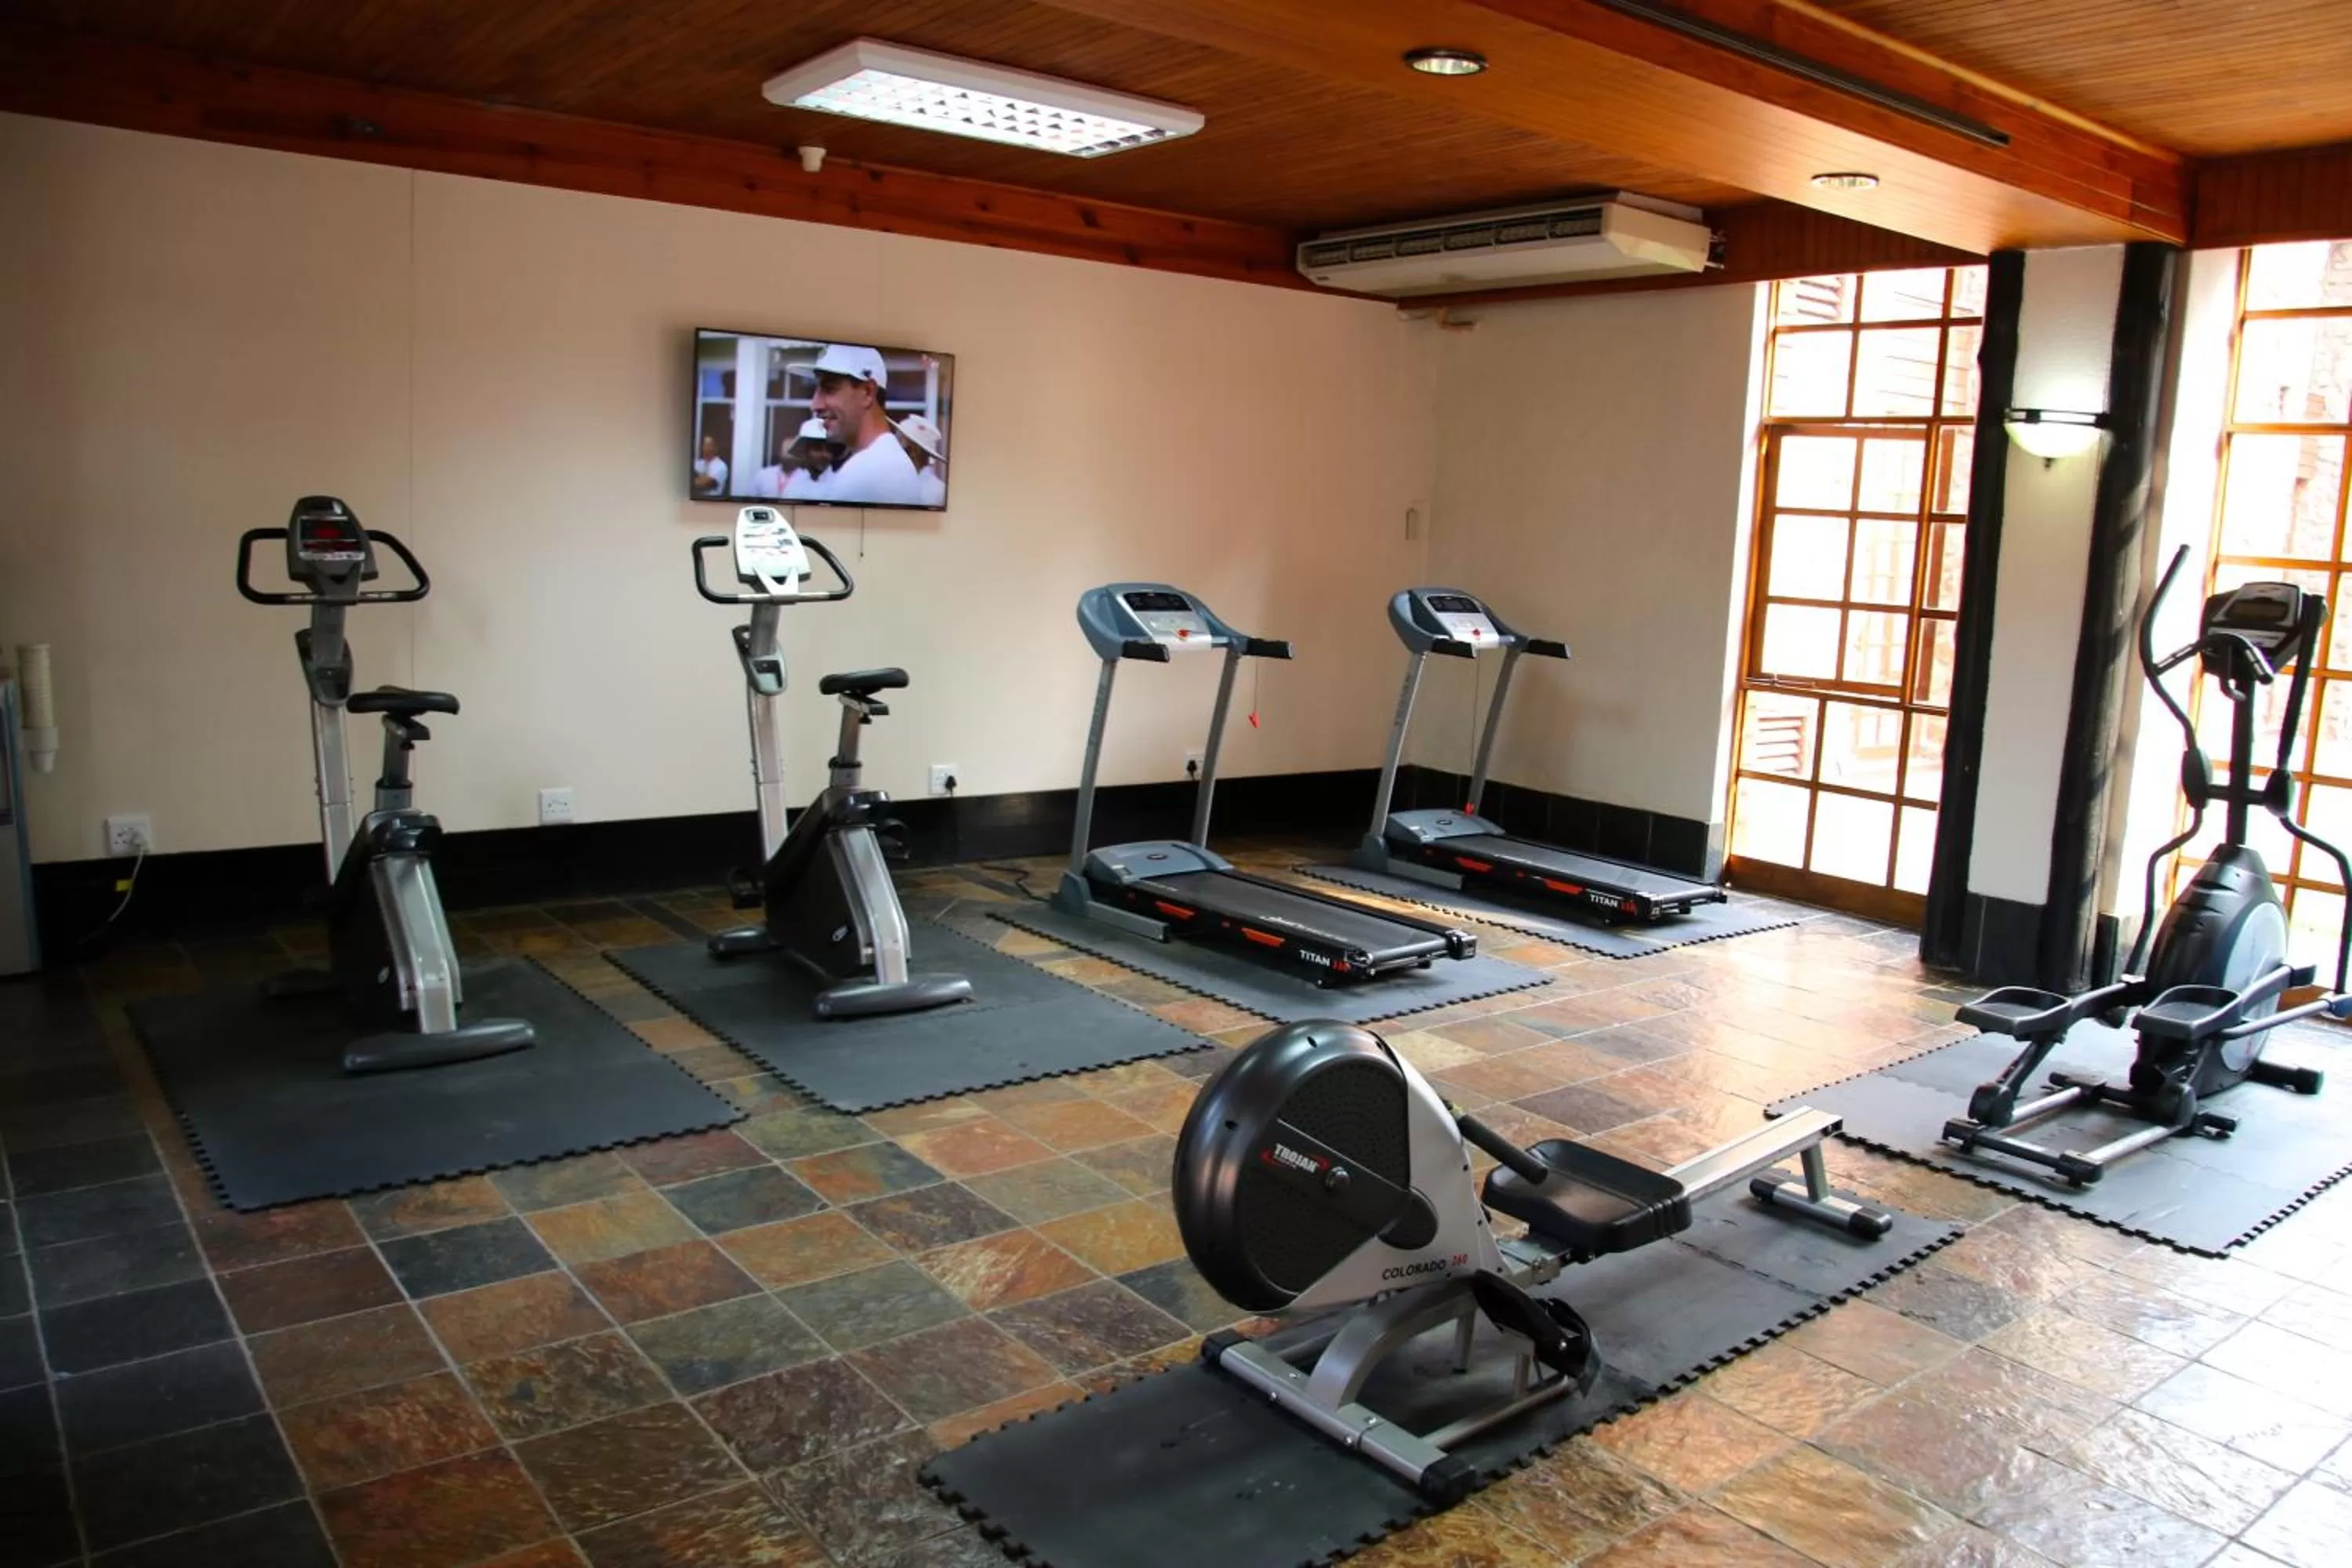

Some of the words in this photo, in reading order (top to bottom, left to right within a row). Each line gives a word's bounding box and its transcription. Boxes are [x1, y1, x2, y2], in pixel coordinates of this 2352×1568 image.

[1590, 895, 1618, 908] TITAN
[1299, 949, 1330, 967] TITAN
[1273, 1143, 1317, 1173] TROJAN
[1382, 1259, 1446, 1280] COLORADO
